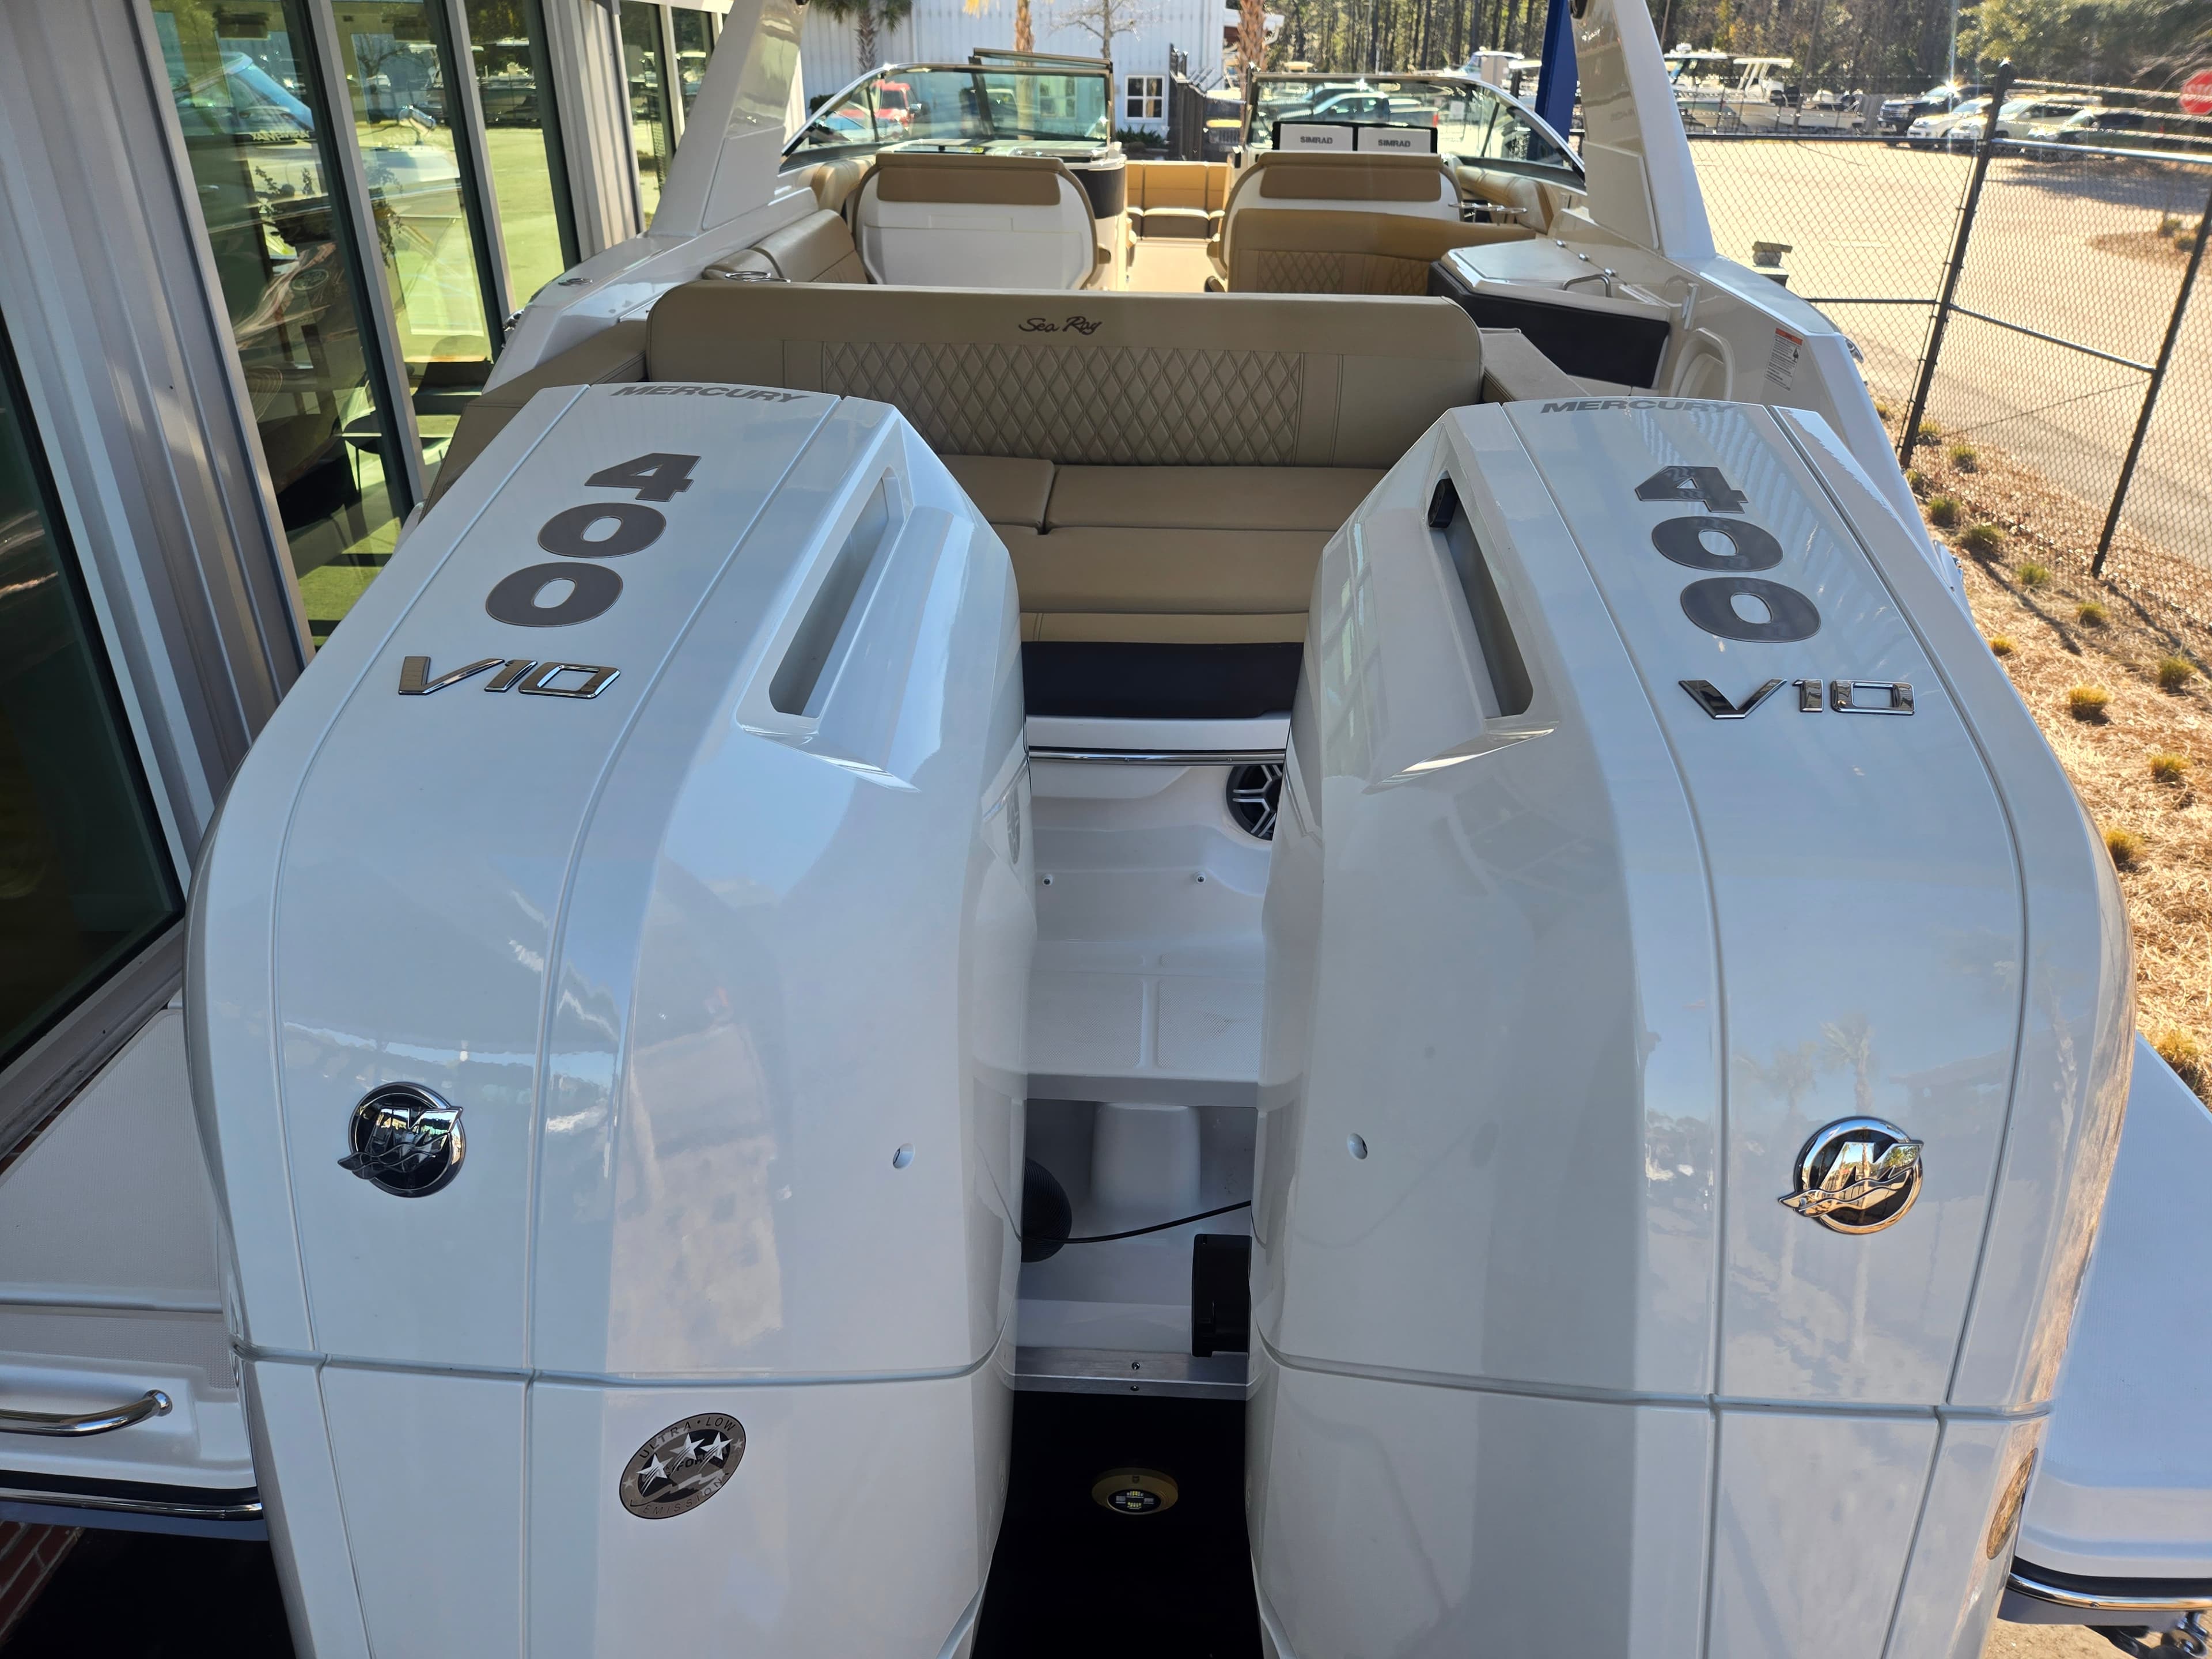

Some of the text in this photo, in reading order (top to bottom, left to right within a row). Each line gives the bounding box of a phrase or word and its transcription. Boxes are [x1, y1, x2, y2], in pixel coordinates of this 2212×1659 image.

[1300, 136, 1333, 144] SIMRAD
[1378, 139, 1411, 147] SIMRAD
[1018, 316, 1103, 335] Sea Ray
[611, 385, 810, 403] MERCURY
[1540, 400, 1738, 414] MERCURY
[486, 453, 701, 627] 400
[1634, 465, 1821, 643] 400
[399, 656, 620, 699] V10
[1678, 679, 1916, 719] V10
[639, 1416, 736, 1459] ULTRA LOW
